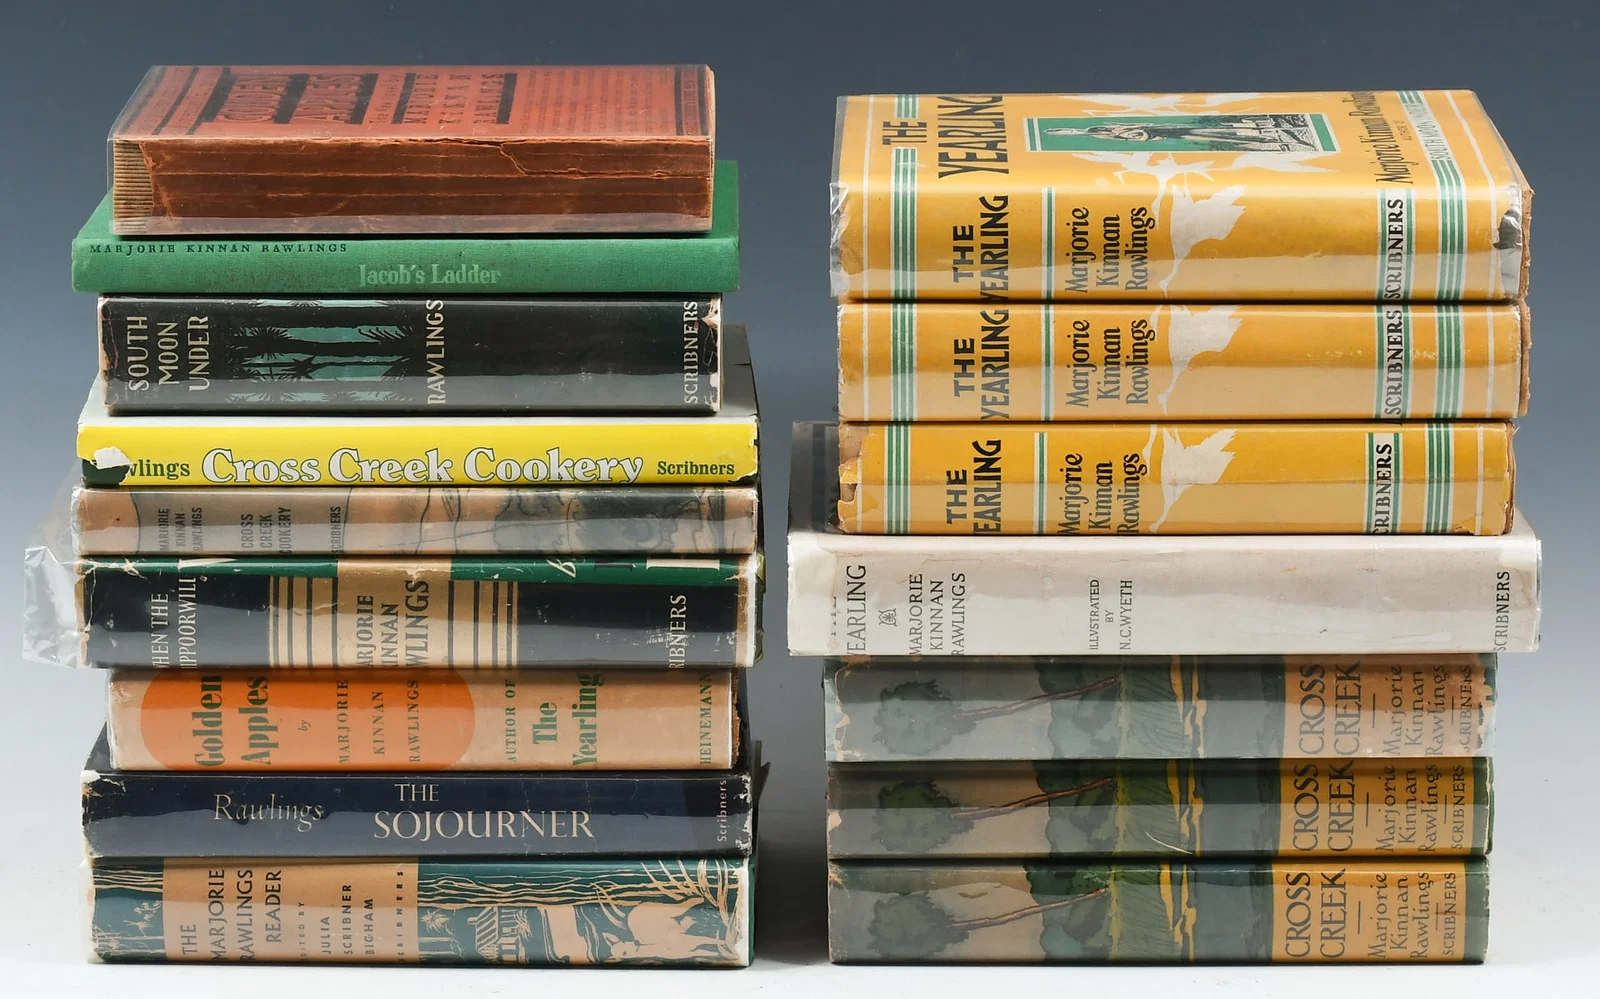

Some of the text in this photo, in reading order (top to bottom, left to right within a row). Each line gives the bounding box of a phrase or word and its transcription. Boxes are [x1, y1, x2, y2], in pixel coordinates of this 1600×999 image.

[882, 121, 927, 146] THE
[1366, 144, 1419, 184] Marjorie
[91, 244, 347, 256] MARJORIE KINNAN RAWLINGS
[431, 264, 501, 284] Ladder
[953, 225, 974, 283] THE
[978, 195, 1009, 301] YEARLING
[1065, 206, 1096, 293] Marjorie
[1096, 214, 1120, 288] Kinnan
[1124, 205, 1156, 290] Rawlings
[1385, 198, 1404, 300] SCRIBNERS
[127, 315, 150, 391] SOUTH
[158, 321, 180, 386] MOON
[188, 315, 211, 392] UNDER
[426, 299, 446, 405] RAWLINGS
[683, 301, 699, 404] SCRIBNERS
[953, 337, 975, 398] THE
[979, 309, 1010, 420] YEARLING
[1066, 319, 1097, 408] Marjorie
[1096, 326, 1121, 401] Kinnan
[1126, 318, 1155, 404] Rawlings
[1384, 309, 1403, 415] SCRIBNERS
[202, 448, 321, 483] Cross
[328, 447, 454, 483] Creek
[463, 447, 644, 485] Cookery
[657, 460, 735, 476] Scribners
[945, 468, 967, 525] THE
[971, 439, 1002, 534] EARLING
[1056, 452, 1088, 534] Marjorie
[1087, 460, 1113, 530] Kinnan
[1117, 452, 1147, 534] Rawlings
[1373, 443, 1392, 534] CRIBNERS
[158, 507, 170, 551] MARJORIE
[175, 512, 186, 547] KINNAN
[240, 512, 254, 549] CROSS
[259, 513, 274, 548] CREEK
[278, 506, 292, 554] COOKERY
[330, 505, 342, 554] SCRIBNERS
[150, 593, 170, 668] HEN THE
[178, 577, 198, 669] IPPOORWILL
[356, 595, 375, 668] ARJORIE
[379, 602, 400, 668] INNAN
[404, 579, 430, 668] WLINGS
[668, 594, 688, 668] RIBNERS
[909, 573, 923, 655] MARJORIE
[929, 579, 944, 651] KINNAN
[951, 572, 966, 655] RAWLINGS
[1105, 609, 1114, 623] BY
[1493, 571, 1511, 652] SCRIBNERS
[191, 675, 226, 767] Golden
[239, 675, 279, 766] Apples
[297, 719, 311, 732] by
[337, 679, 349, 764] MARJORIE
[372, 690, 384, 755] KINNAN
[408, 679, 421, 763] RAWLINGS
[504, 678, 516, 763] AUTHOR OF
[532, 701, 558, 745] The
[573, 674, 605, 766] Yearling
[700, 673, 712, 764] HEINEMANN
[1299, 664, 1326, 755] CROSS
[1334, 660, 1362, 756] CREEK
[1383, 664, 1406, 756] Marjorie
[1405, 669, 1425, 746] Kinnan
[1425, 664, 1449, 756] Rawlings
[213, 783, 440, 833] Rawlings THE
[373, 810, 595, 842] SOJOURNER
[716, 779, 727, 842] Scribners
[1293, 763, 1321, 852] CROSS
[1328, 760, 1356, 852] CREEK
[1376, 764, 1400, 852] Marjorie
[1398, 767, 1418, 844] Kinnan
[1418, 764, 1443, 853] Rawlings
[1450, 764, 1465, 849] SCRIBNERS
[182, 924, 197, 956] THE
[208, 868, 228, 961] MARJORIE
[236, 868, 256, 961] RAWLINGS
[264, 869, 283, 943] READER
[297, 902, 305, 917] BY
[320, 916, 333, 955] JULIA
[341, 884, 353, 955] SCRIBNER
[363, 898, 375, 955] BIGHAM
[1285, 871, 1312, 958] CROSS
[1320, 867, 1347, 959] CREEK
[1368, 871, 1393, 960] Marjorie
[1390, 875, 1409, 951] Kinnan
[1410, 871, 1435, 959] Rawlings
[1443, 871, 1457, 956] SCRIBNERS
